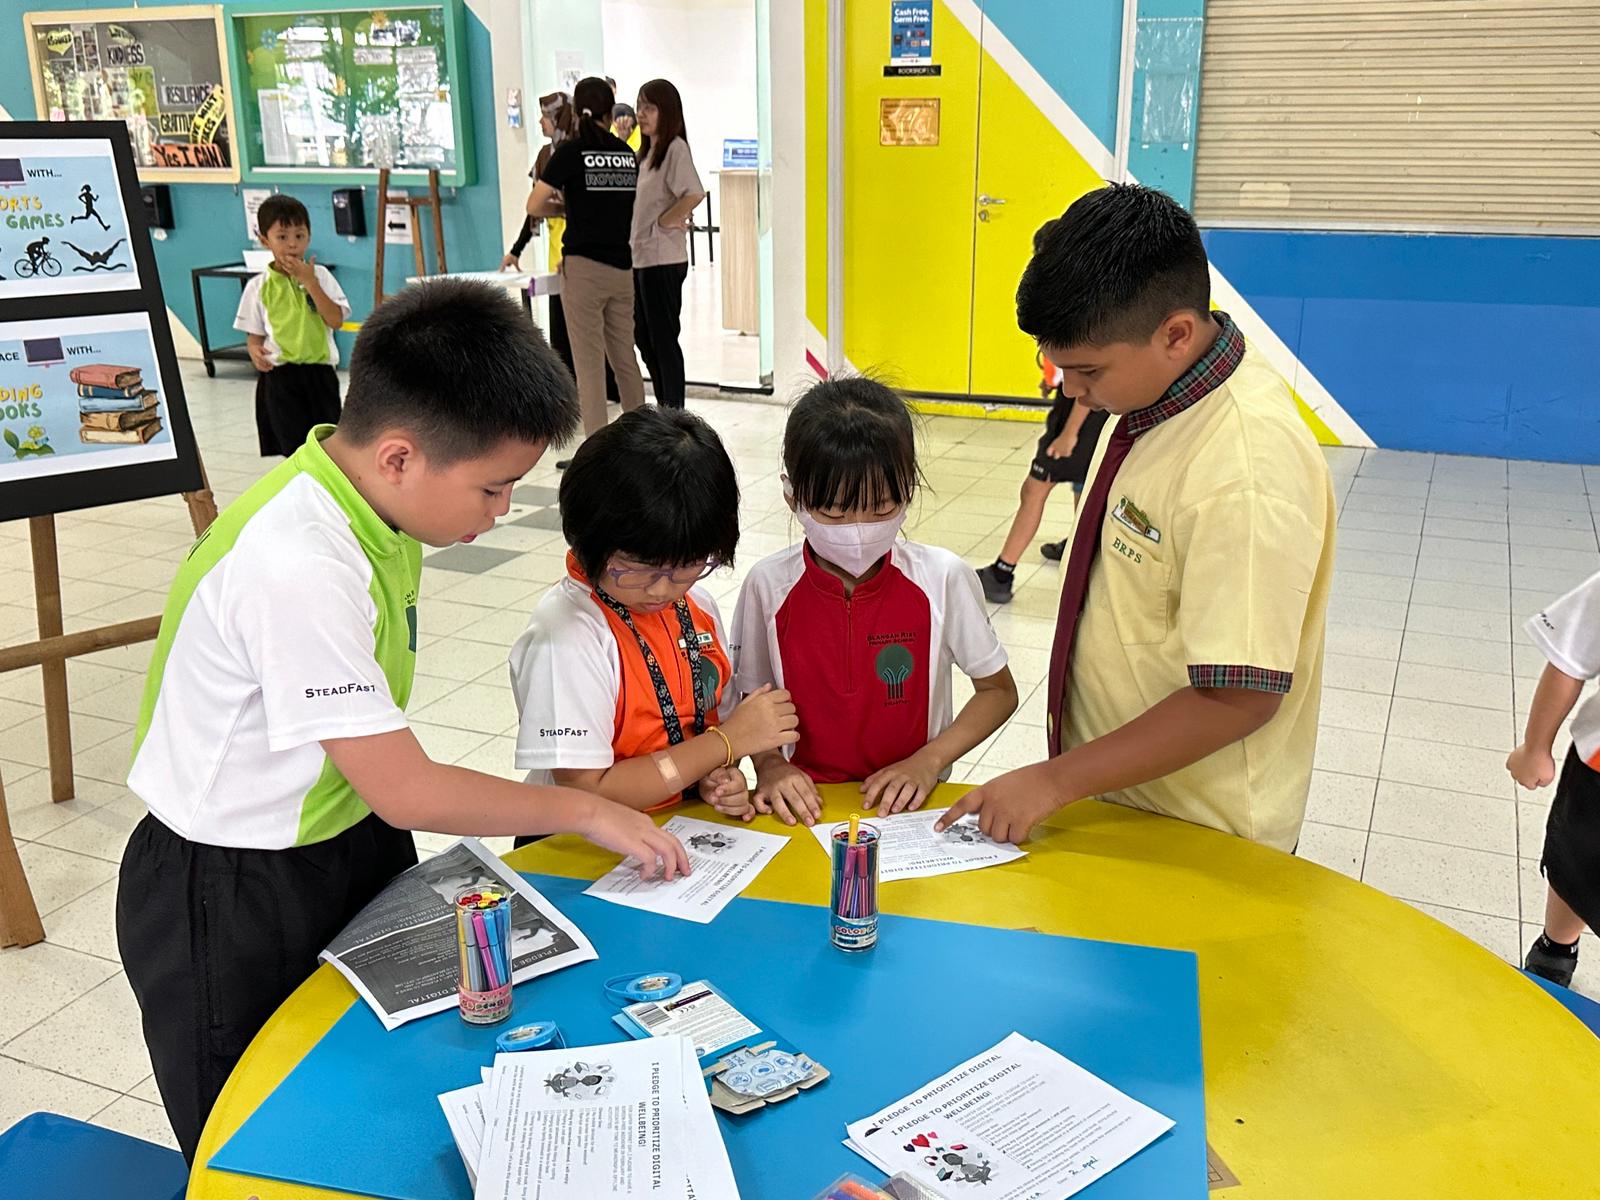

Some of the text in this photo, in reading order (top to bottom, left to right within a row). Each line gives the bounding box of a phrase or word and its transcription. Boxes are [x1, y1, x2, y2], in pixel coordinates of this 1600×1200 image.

[895, 8, 912, 16] Cash
[160, 113, 194, 133] GRATITU
[584, 155, 636, 168] GOTONG
[27, 168, 63, 178] WITH...
[0, 195, 43, 212] ORTS
[6, 213, 65, 230] GAMES
[0, 384, 43, 403] DING
[1112, 537, 1142, 564] BRPS
[408, 989, 449, 1004] DIGITAL
[651, 1067, 660, 1094] PLEDGE
[878, 1105, 911, 1125] PLEDGE
[910, 1098, 923, 1108] TO
[922, 1070, 970, 1101] PRIORITIZE
[968, 1054, 1002, 1074] DIGITAL
[651, 1096, 660, 1106] TO
[898, 1113, 930, 1132] PLEDGE
[930, 1107, 943, 1116] TO
[942, 1080, 990, 1110] PRIORITIZE
[988, 1062, 1022, 1083] DIGITAL
[943, 1090, 993, 1120] WELLBEING!
[638, 1101, 647, 1148] WELLBEING!
[652, 1108, 661, 1152] PRIORITIZE
[652, 1155, 661, 1190] DIGITAL
